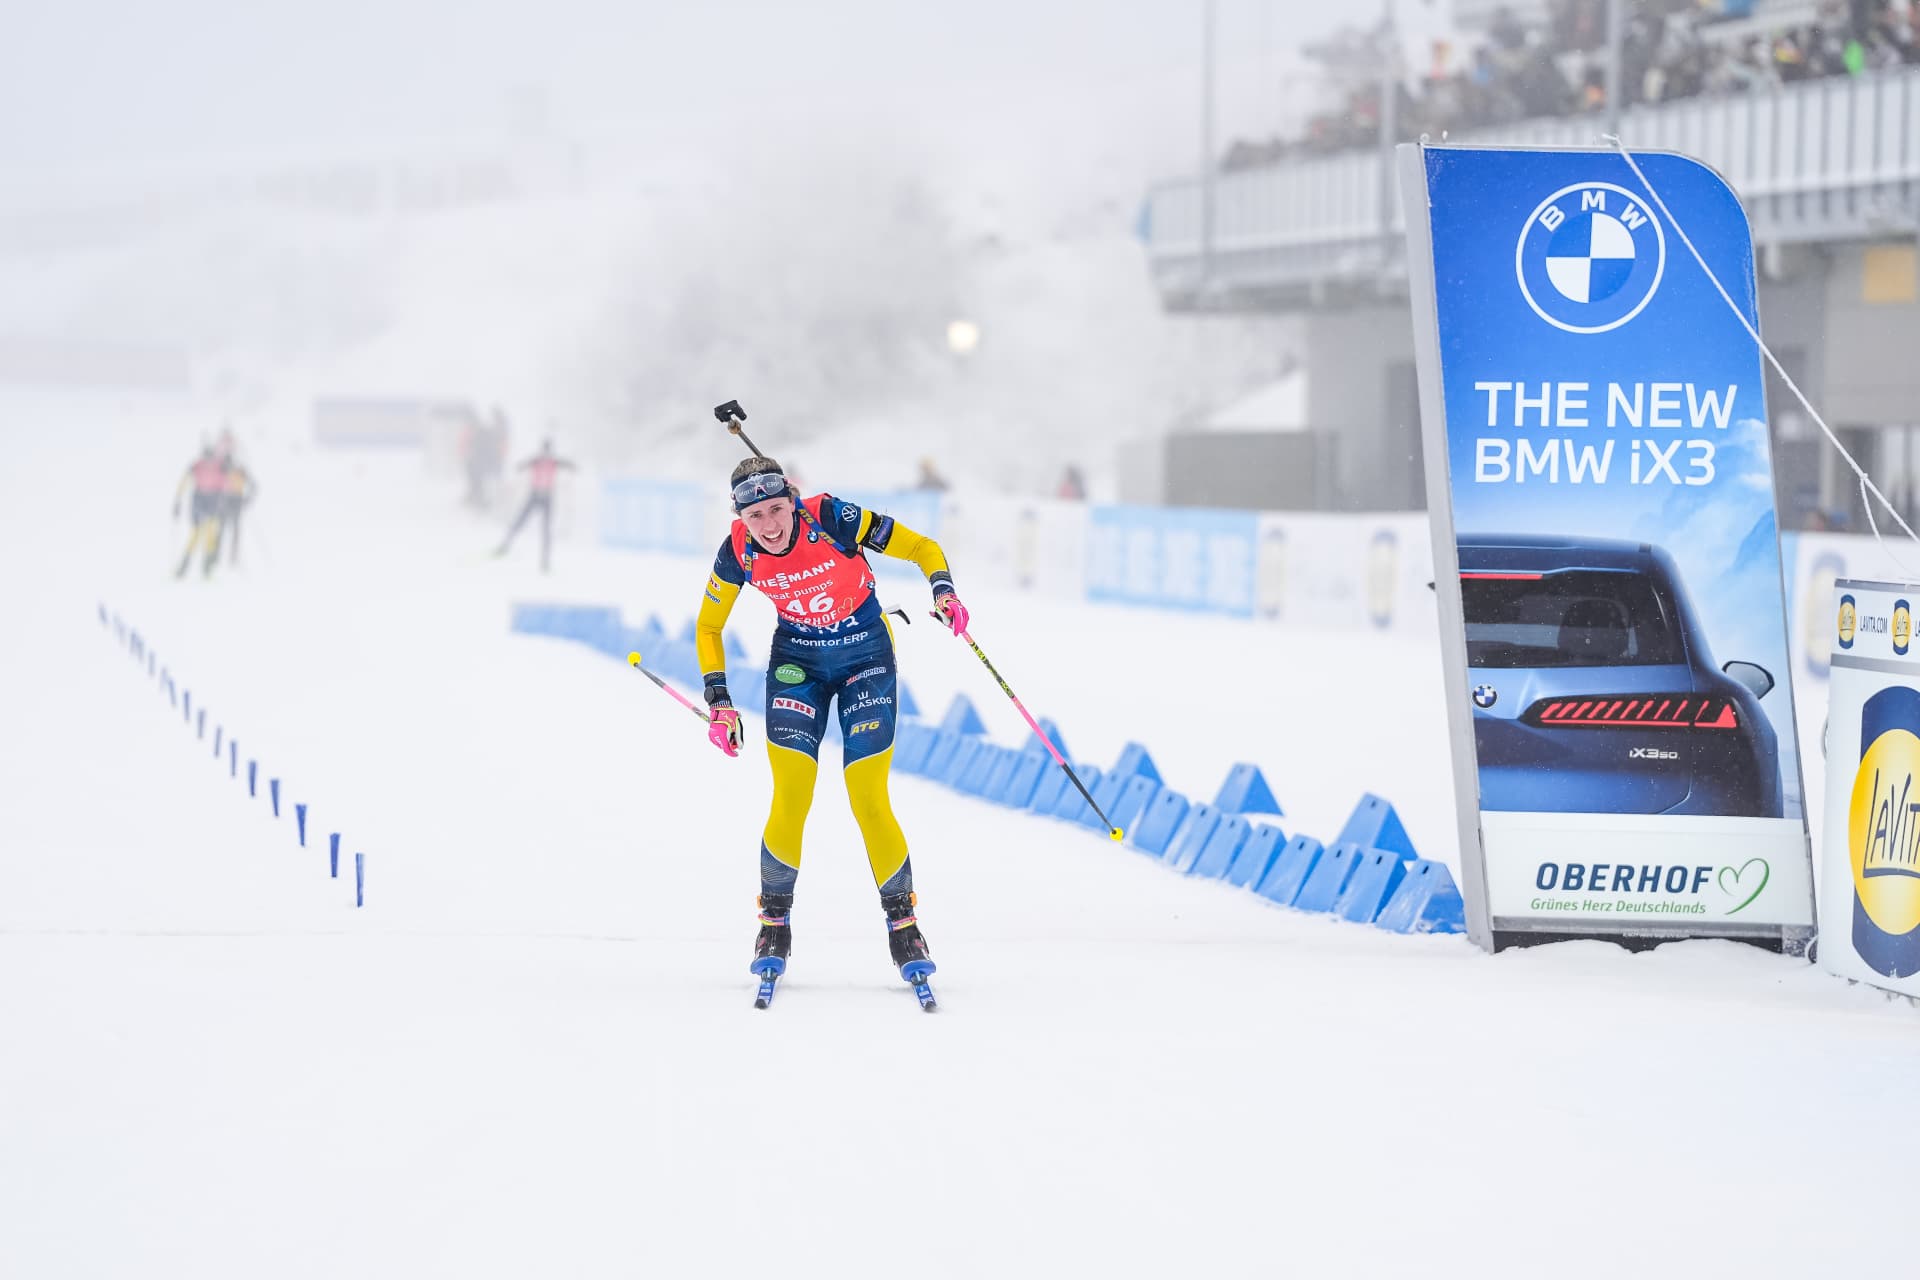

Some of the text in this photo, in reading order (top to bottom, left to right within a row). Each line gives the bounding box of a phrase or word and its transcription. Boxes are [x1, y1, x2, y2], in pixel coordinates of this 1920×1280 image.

[1538, 190, 1647, 232] BMW
[1475, 381, 1738, 430] THE NEW
[1474, 438, 1716, 486] BMW iX3
[793, 579, 834, 599] pumps
[785, 591, 835, 617] 46
[791, 631, 869, 647] Monitor ERP
[774, 699, 816, 717] NIBE
[843, 696, 892, 718] SVEASKOG
[851, 721, 880, 735] ATG
[1536, 862, 1713, 893] OBERHOF
[1530, 897, 1707, 915] Grünes Herz Deutschlands
